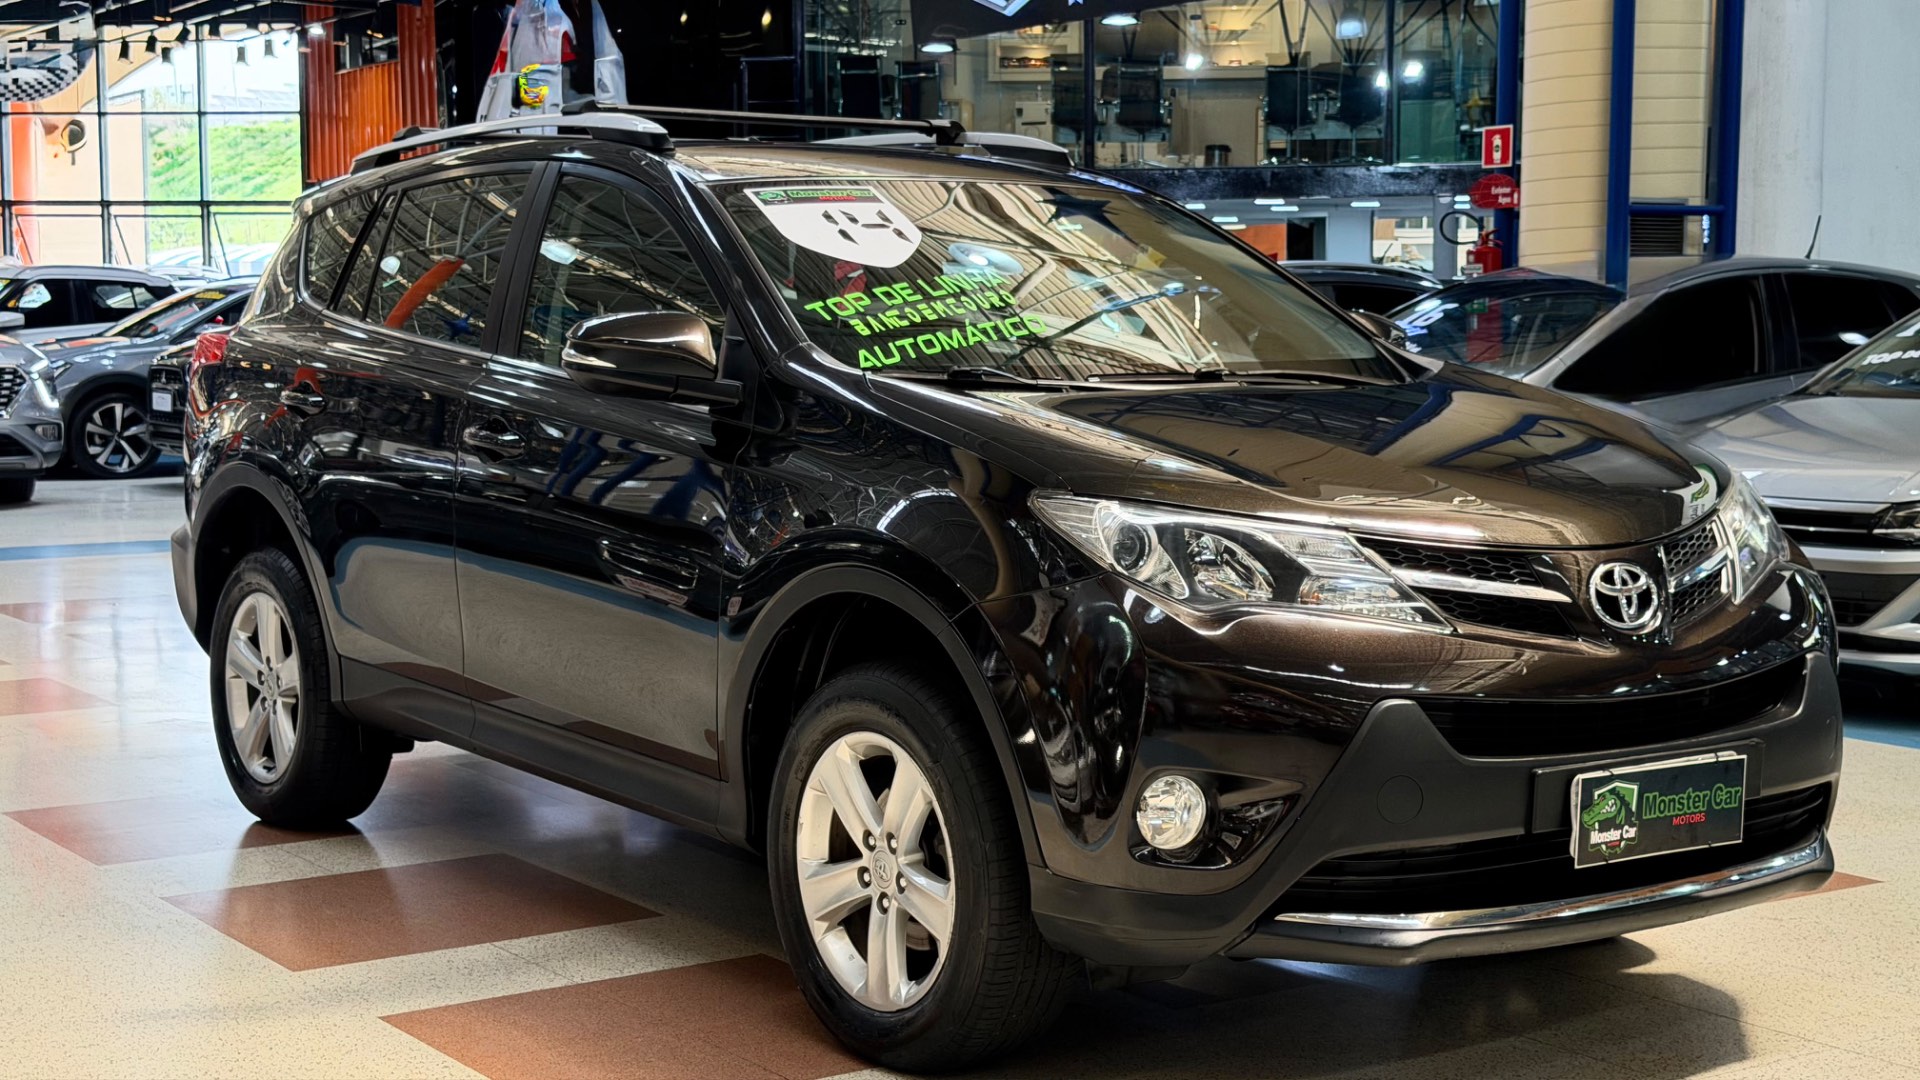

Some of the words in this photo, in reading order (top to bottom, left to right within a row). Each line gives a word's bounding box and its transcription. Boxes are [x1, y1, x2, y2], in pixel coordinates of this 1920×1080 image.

[804, 291, 871, 321] TOP
[872, 282, 923, 306] DE
[918, 268, 1011, 297] LINHA
[858, 314, 1047, 369] AUTOMÁTICO
[1642, 787, 1711, 820] Monster
[1711, 783, 1742, 809] Car
[1672, 812, 1706, 826] MOTORS
[1590, 827, 1621, 844] Monster
[1622, 824, 1637, 839] Car
